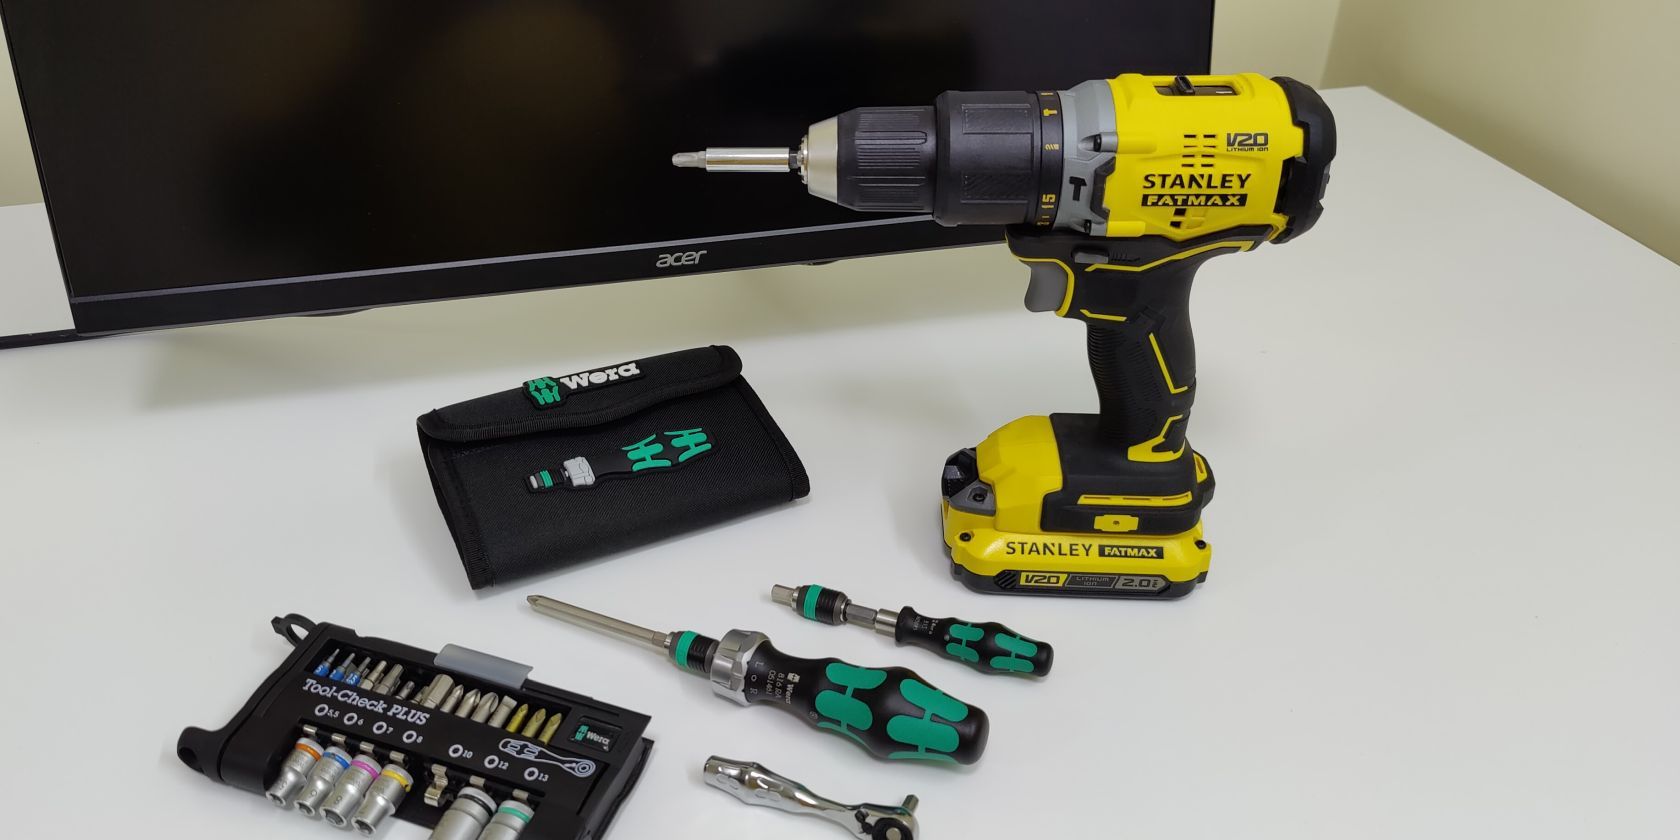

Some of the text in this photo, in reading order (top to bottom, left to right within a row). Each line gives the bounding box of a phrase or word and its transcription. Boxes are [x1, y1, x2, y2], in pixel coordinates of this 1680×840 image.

[1226, 132, 1269, 147] V20
[1142, 173, 1252, 189] STANLEY
[1146, 194, 1241, 206] FATMAX
[655, 250, 708, 268] acer
[559, 362, 641, 390] Wera
[1005, 541, 1158, 558] STANLEY FATMAX
[1024, 573, 1061, 585] V20
[1121, 577, 1151, 588] 2.0
[302, 678, 431, 726] Tool-Check PLUS
[357, 718, 365, 727] 6
[386, 726, 394, 735] 7
[416, 735, 424, 744] 8
[586, 730, 610, 745] Wera
[462, 749, 473, 760] 10
[498, 760, 509, 771] 12
[537, 771, 549, 783] 13
